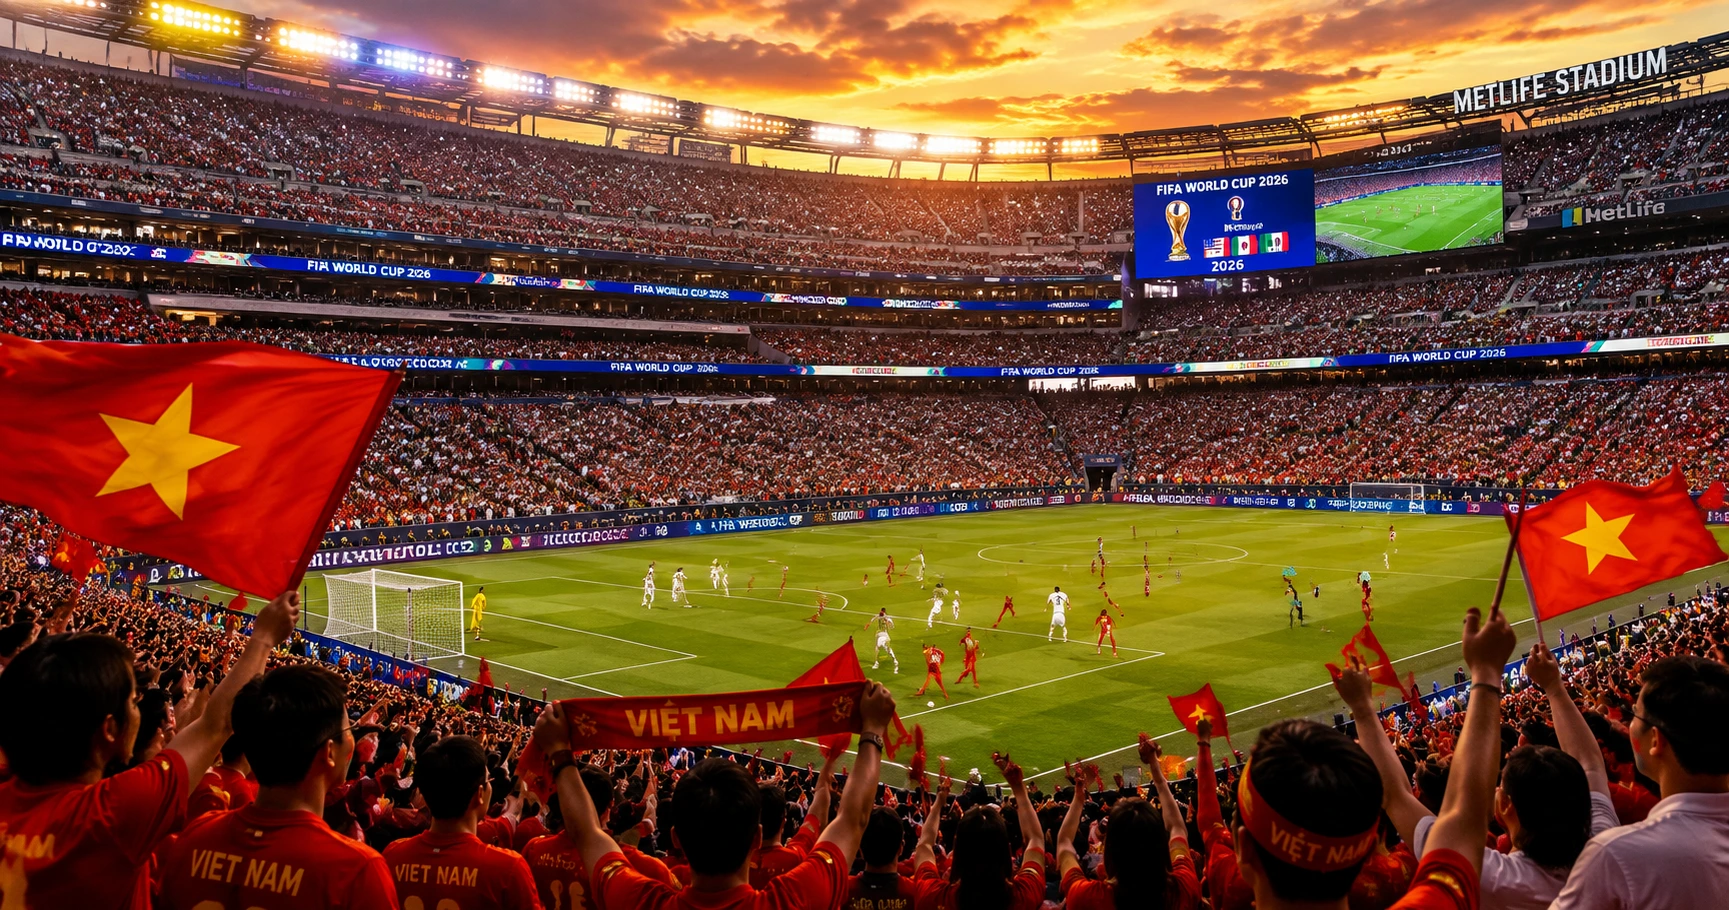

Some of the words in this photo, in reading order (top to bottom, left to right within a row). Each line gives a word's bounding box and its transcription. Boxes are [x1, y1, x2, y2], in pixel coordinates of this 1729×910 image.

[1453, 72, 1547, 114] METLIFE
[1555, 46, 1667, 95] STADIUM
[1156, 184, 1183, 196] FIFA
[1185, 179, 1228, 193] WORLD
[1231, 176, 1256, 189] CUP
[1258, 174, 1289, 187] 2026
[332, 262, 377, 275] WORLD
[380, 266, 405, 277] CUP
[1211, 259, 1245, 272] 2026
[1412, 351, 1451, 362] WORLD
[1454, 349, 1477, 359] CUP
[1479, 348, 1506, 358] 2026
[634, 363, 670, 372] WORLD
[1057, 367, 1076, 375] CUP
[625, 699, 702, 742] VIỆT
[713, 699, 795, 735] NAM
[190, 849, 243, 883] VIET
[244, 858, 305, 897] NAM
[395, 863, 431, 883] VIET
[436, 865, 478, 887] NAM
